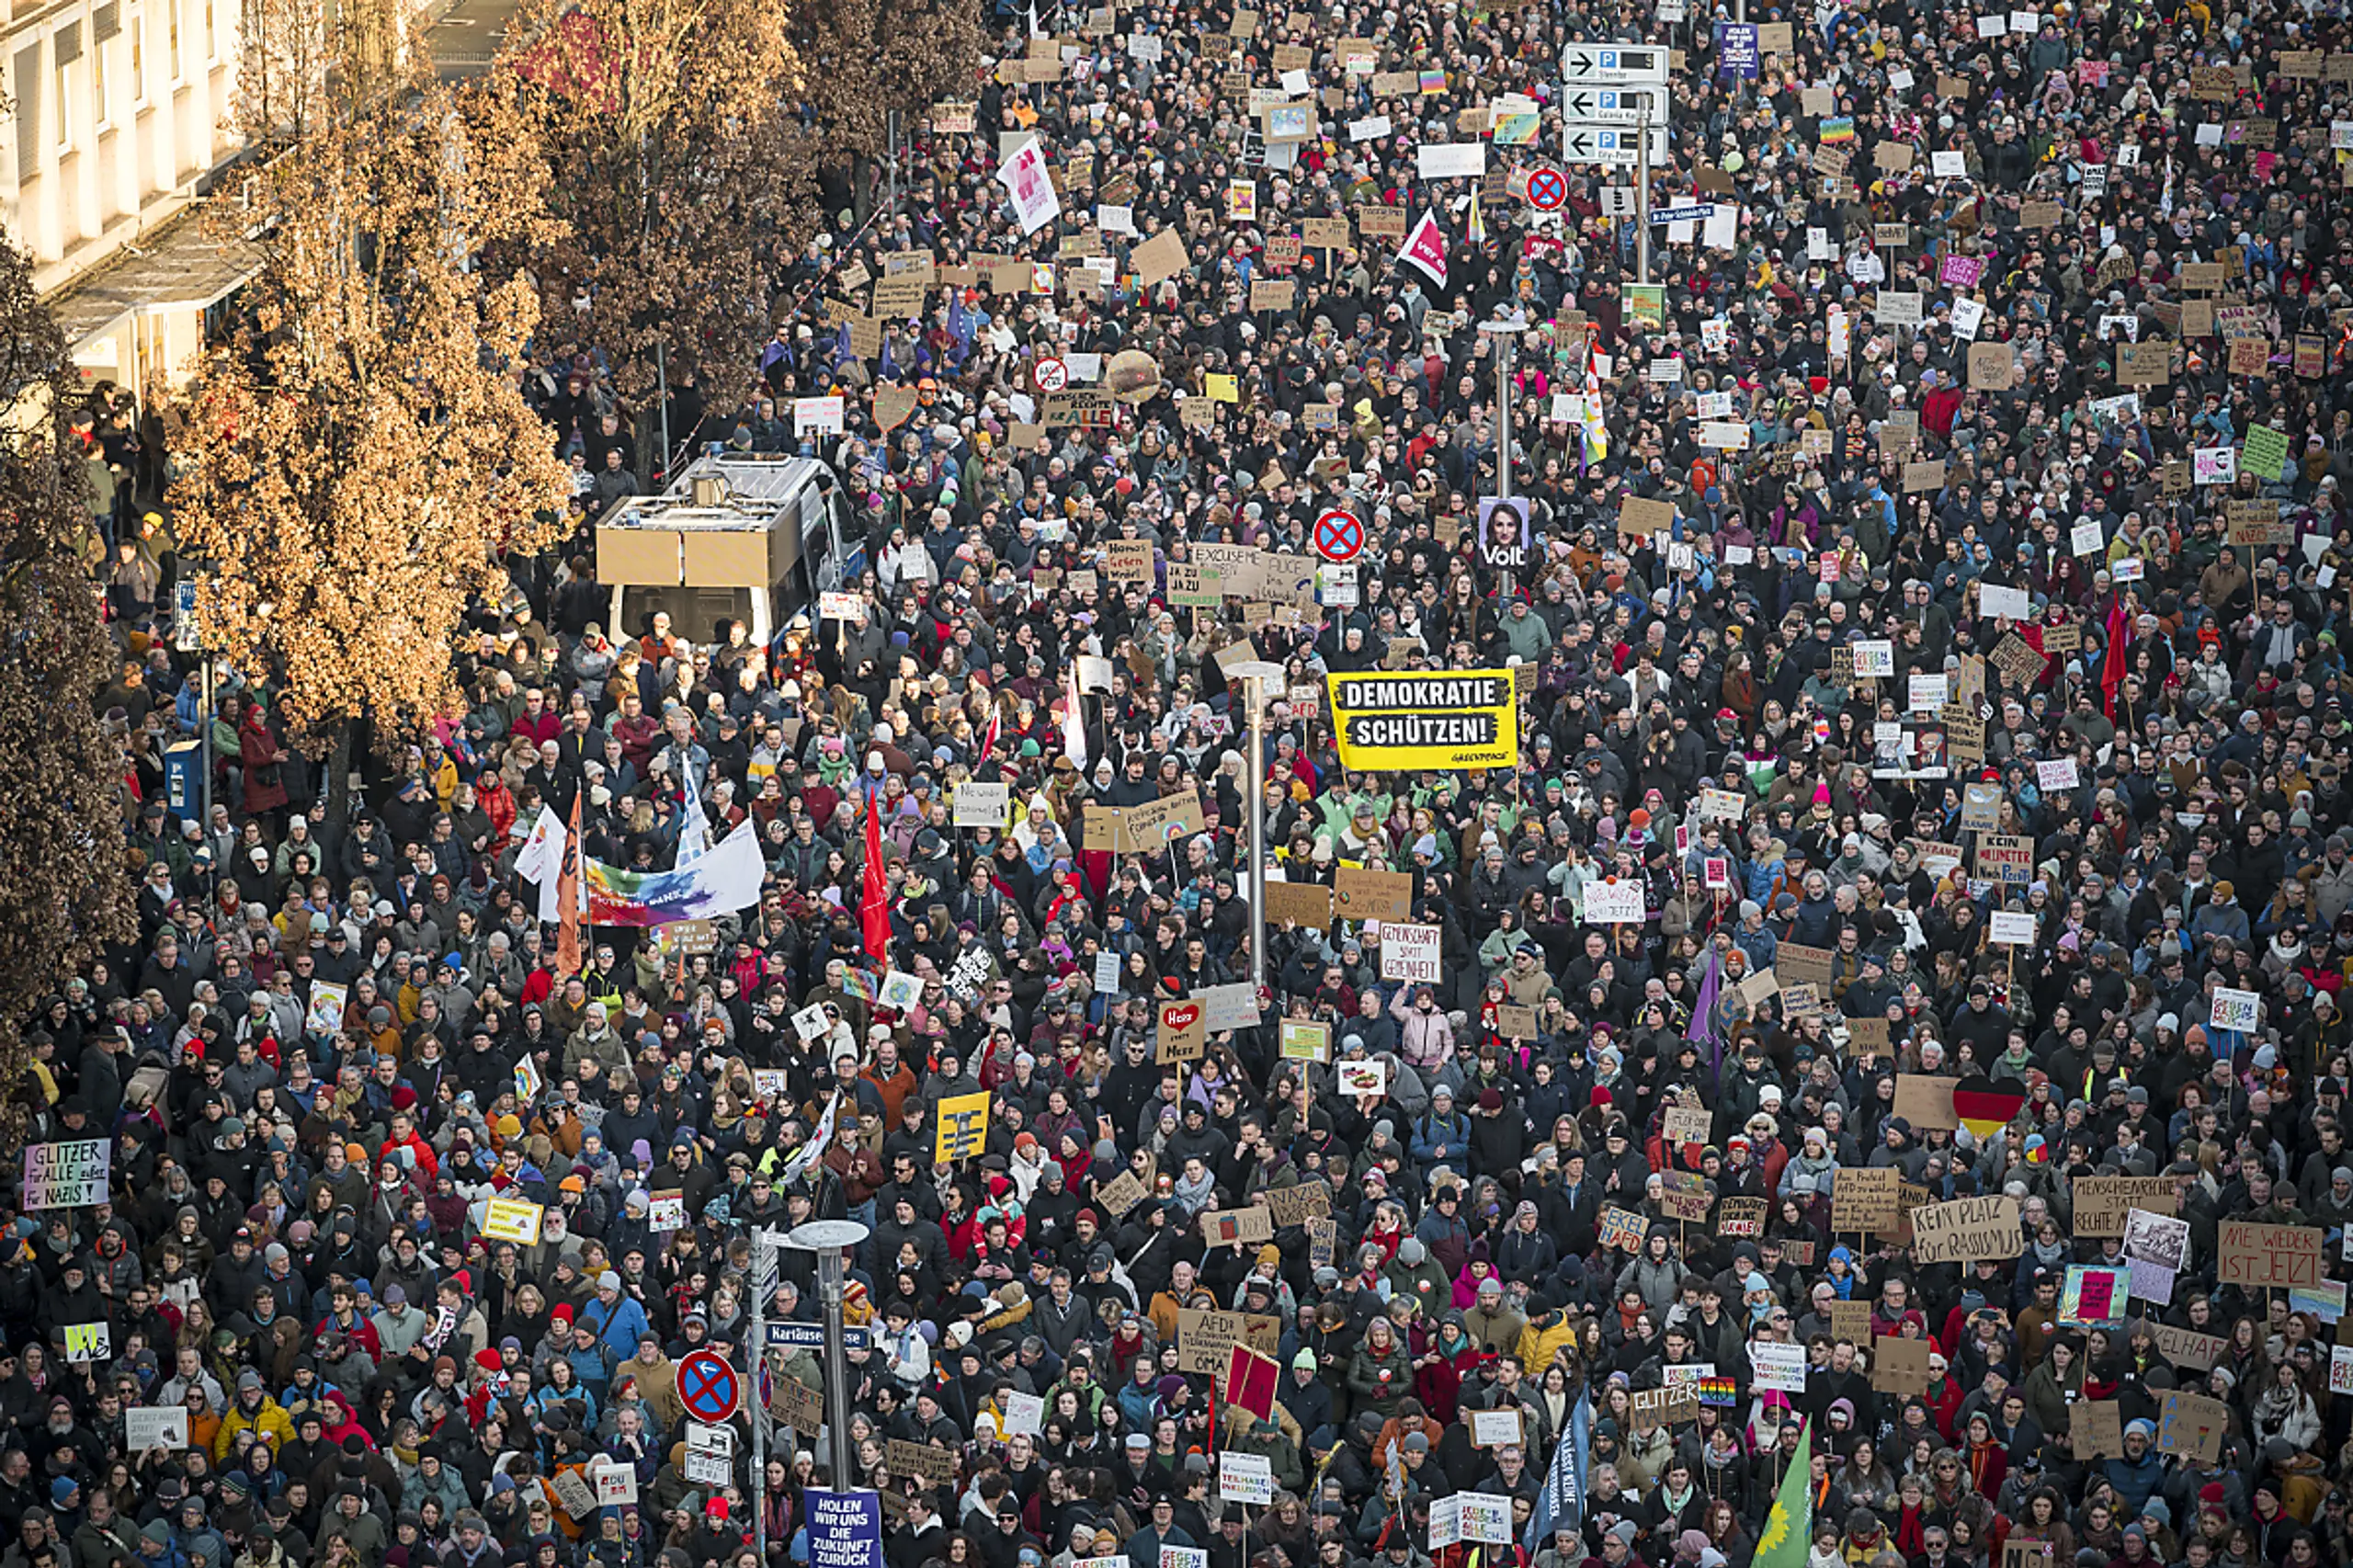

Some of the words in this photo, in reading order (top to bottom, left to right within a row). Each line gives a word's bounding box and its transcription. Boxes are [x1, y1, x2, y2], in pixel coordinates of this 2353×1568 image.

[1065, 409, 1111, 425] ALLE
[2235, 528, 2267, 542] NAZIS
[1483, 545, 1525, 566] Volt
[1186, 581, 1199, 593] ZU
[1347, 681, 1495, 708] DEMOKRATIE
[1356, 715, 1487, 744] SCHÜTZEN!
[1450, 751, 1508, 762] GREENPEACE
[1986, 837, 2019, 848] KEIN
[1980, 849, 2030, 865] MILLIMETER
[1381, 926, 1438, 946] GEMEINSCHAFT
[1399, 947, 1423, 958] STATT
[1384, 960, 1435, 981] GEMEINHEIT
[34, 1142, 101, 1165] GLITZER
[43, 1165, 74, 1182] ALLE
[1857, 1169, 1885, 1181] Protest
[1272, 1185, 1321, 1204] NAZIS
[1837, 1182, 1854, 1193] AfD
[2075, 1178, 2175, 1196] MENSCHENRECHTE
[2105, 1196, 2141, 1209] STATT
[1607, 1210, 1645, 1236] EKEL
[1914, 1207, 1953, 1233] KEIN
[1960, 1197, 2001, 1225] PLATZ
[2075, 1211, 2111, 1231] RECHTE
[1600, 1226, 1641, 1251] HAFD
[1918, 1237, 1942, 1262] für
[1948, 1229, 2021, 1256] RASSISMUS
[2223, 1228, 2253, 1248] NIE
[2260, 1229, 2313, 1249] WIEDER
[2222, 1255, 2258, 1279] IST
[2258, 1249, 2317, 1285] JETZT
[66, 1324, 97, 1353] NO
[772, 1326, 861, 1344] Kartäusesse
[2154, 1327, 2225, 1362] ELHAF
[1194, 1358, 1224, 1372] OMA
[1634, 1381, 1697, 1410] GLITZER
[818, 1498, 862, 1513] HOLEN
[814, 1513, 838, 1525] WIR
[839, 1513, 869, 1526] UNS
[829, 1528, 850, 1540] DIE
[813, 1540, 873, 1553] ZUKUNFT
[817, 1550, 870, 1566] ZURÜCK
[1071, 1558, 1117, 1568] GEGEN
[1162, 1550, 1202, 1563] GEGEN
